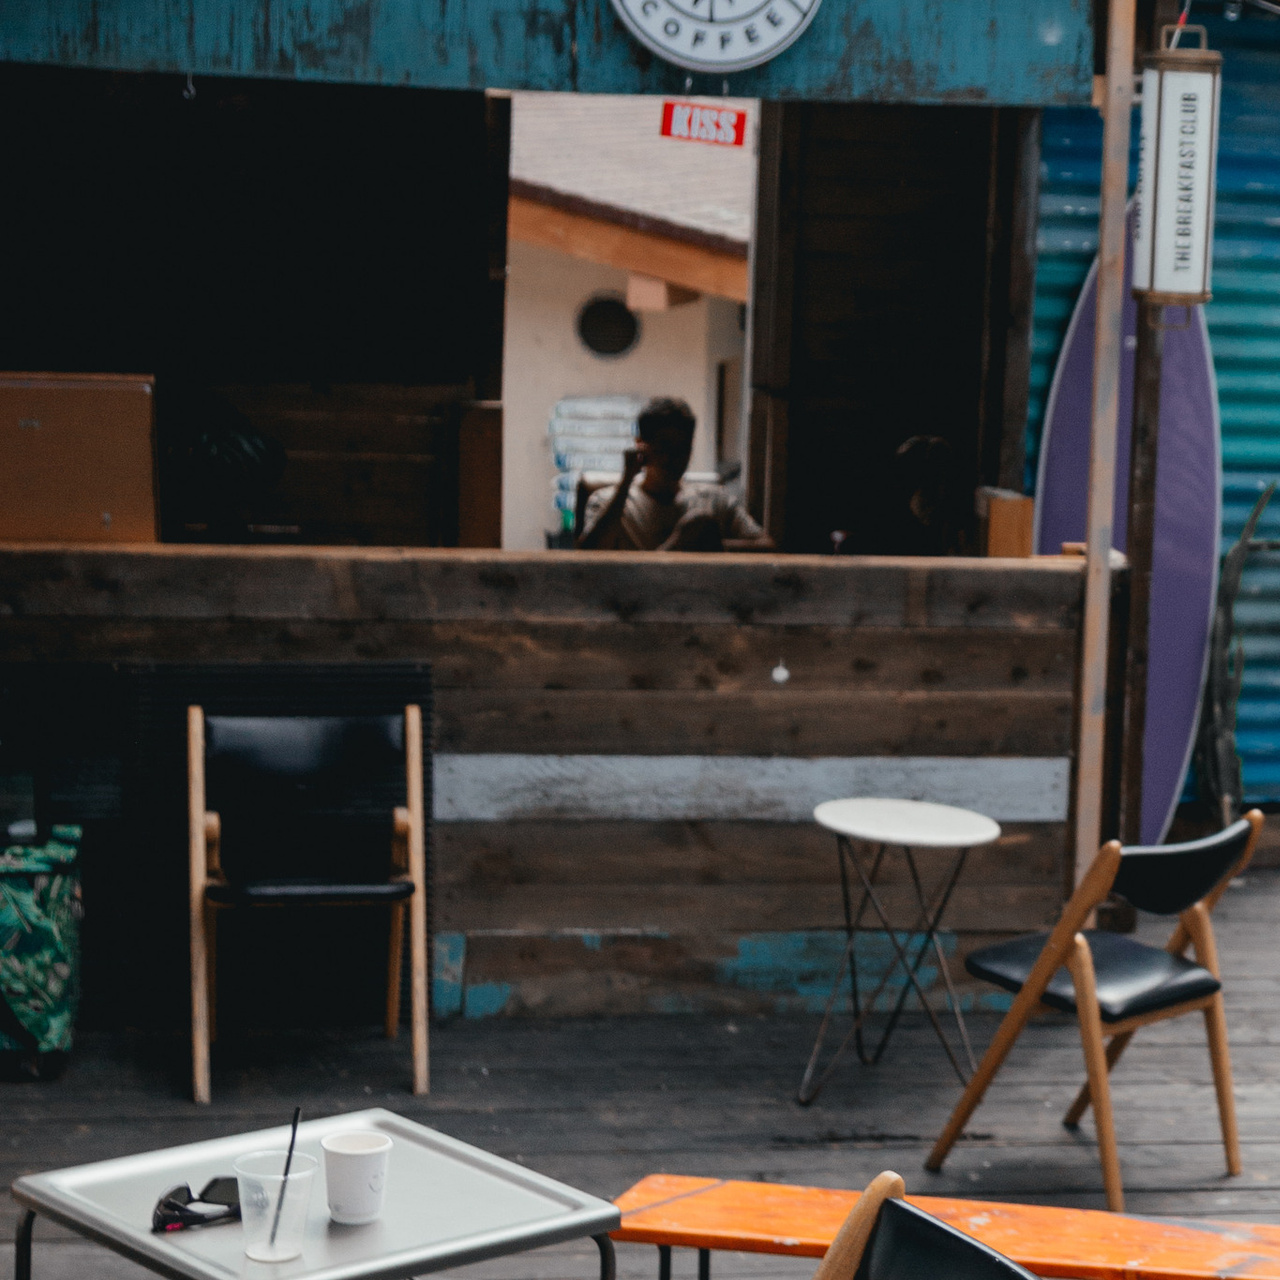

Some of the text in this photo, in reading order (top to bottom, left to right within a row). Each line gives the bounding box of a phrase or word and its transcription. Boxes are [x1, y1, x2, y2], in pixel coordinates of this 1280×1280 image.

[669, 104, 738, 145] KISS
[1174, 92, 1198, 271] THE BREAKFAST CLUB
